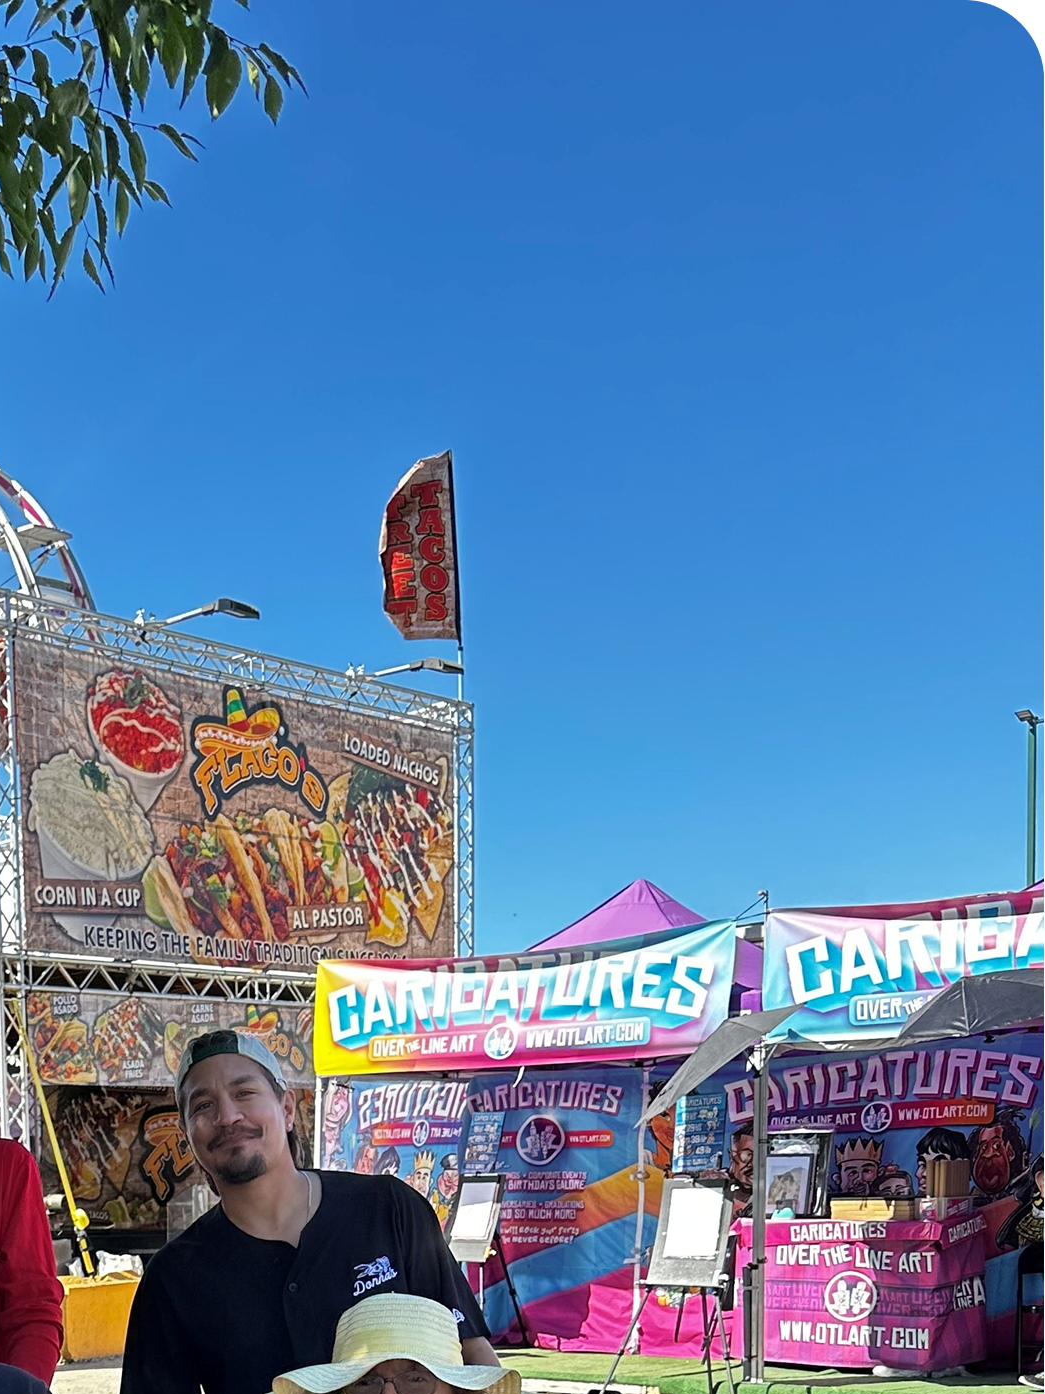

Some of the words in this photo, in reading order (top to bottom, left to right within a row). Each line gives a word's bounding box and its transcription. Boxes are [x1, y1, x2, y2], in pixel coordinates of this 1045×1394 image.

[410, 480, 449, 621] TACOS
[344, 734, 391, 767] LOADED
[393, 755, 440, 786] NACHOS
[34, 885, 77, 907] CORN
[81, 886, 98, 907] IN
[99, 886, 113, 908] A
[115, 887, 141, 907] CUP
[293, 910, 310, 929] AL
[312, 907, 364, 928] PASTOR
[83, 925, 157, 952] KEEPING
[163, 932, 191, 956] THE
[195, 936, 252, 961] FAMILY
[191, 1004, 214, 1014] CARNE
[329, 952, 714, 1043] CARICATURES
[857, 996, 903, 1021] OVER
[191, 1013, 215, 1023] ASADA
[372, 1040, 405, 1058] OVER
[421, 1037, 448, 1055] LINE
[450, 1033, 477, 1052] ART
[525, 1022, 644, 1048] WWW.OTLART.COM
[122, 1059, 145, 1070] ASADA
[124, 1069, 144, 1079] FRIES
[724, 1048, 1042, 1123] CARICATURES
[809, 1114, 834, 1126] LINE
[835, 1112, 856, 1125] ART
[898, 1104, 988, 1121] WWW.OTLART.COM
[508, 1180, 555, 1190] BIRTHDAYS
[556, 1180, 586, 1190] GALORE
[514, 1209, 525, 1219] SO
[528, 1209, 552, 1219] MUCH
[790, 1221, 887, 1242] CARICATURES
[776, 1244, 819, 1265] OVER
[821, 1244, 852, 1267] THE
[855, 1247, 893, 1271] LINE
[898, 1252, 935, 1273] ART
[780, 1320, 929, 1350] WWW.OTLART.COM
